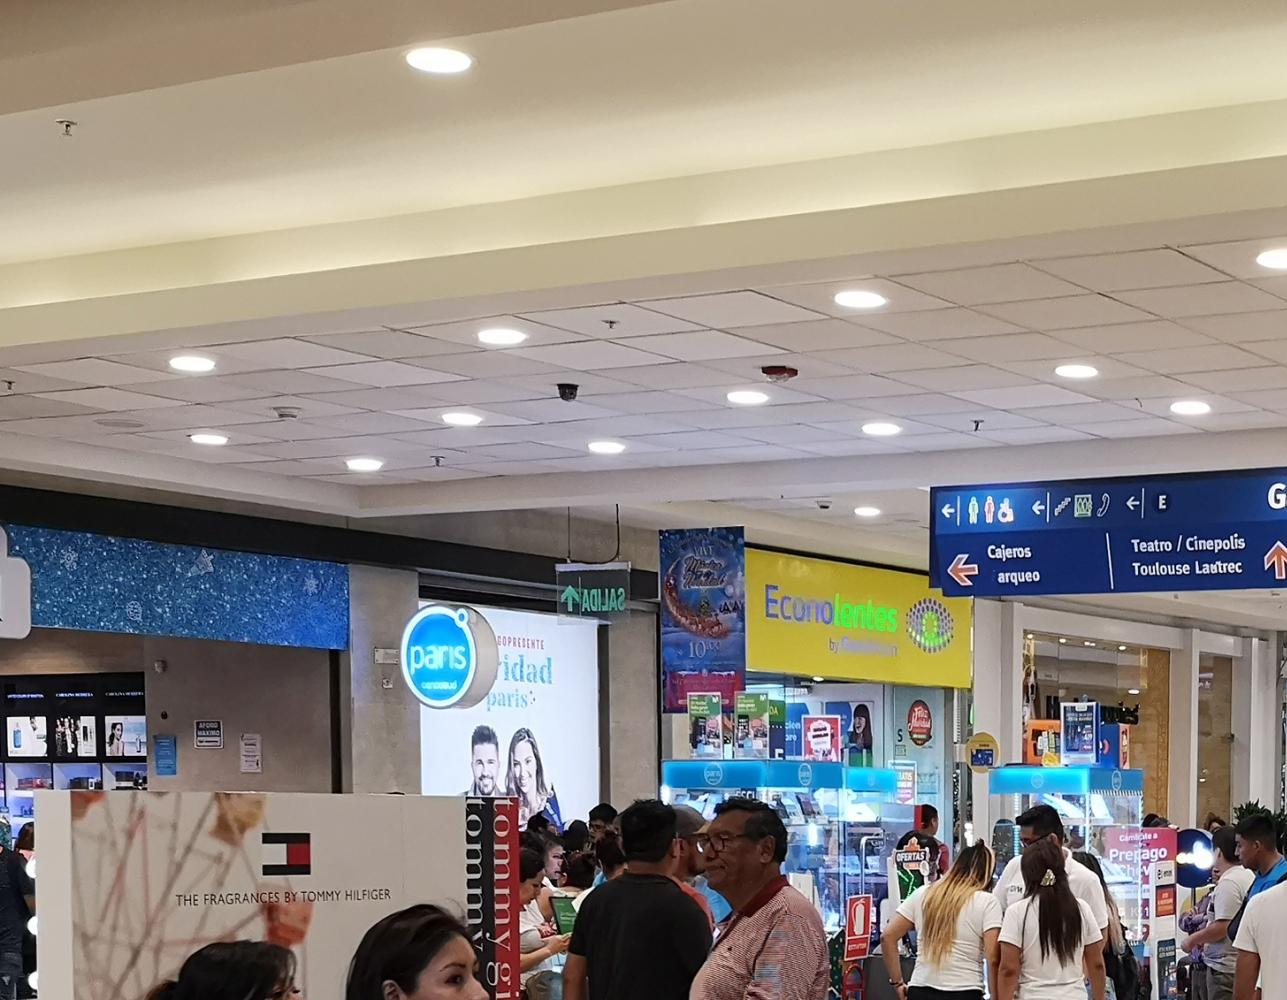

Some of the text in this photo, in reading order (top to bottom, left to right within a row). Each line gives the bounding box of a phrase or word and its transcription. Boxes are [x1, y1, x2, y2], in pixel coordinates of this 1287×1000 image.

[1131, 538, 1172, 553] Teatro
[1185, 534, 1246, 552] Cinepolis
[987, 544, 1032, 562] Cajeros
[1132, 559, 1242, 576] Toulouse Lautrec
[997, 569, 1041, 586] arqueo
[765, 584, 898, 633] Econolentes
[410, 643, 467, 674] paris
[500, 654, 552, 685] idad
[486, 689, 528, 711] paris
[896, 851, 925, 862] OFERTAS
[1109, 847, 1168, 864] Prepago
[486, 799, 514, 951] tommy
[176, 888, 391, 906] THE FRAGRANCES BY TOMMY HILFIGER
